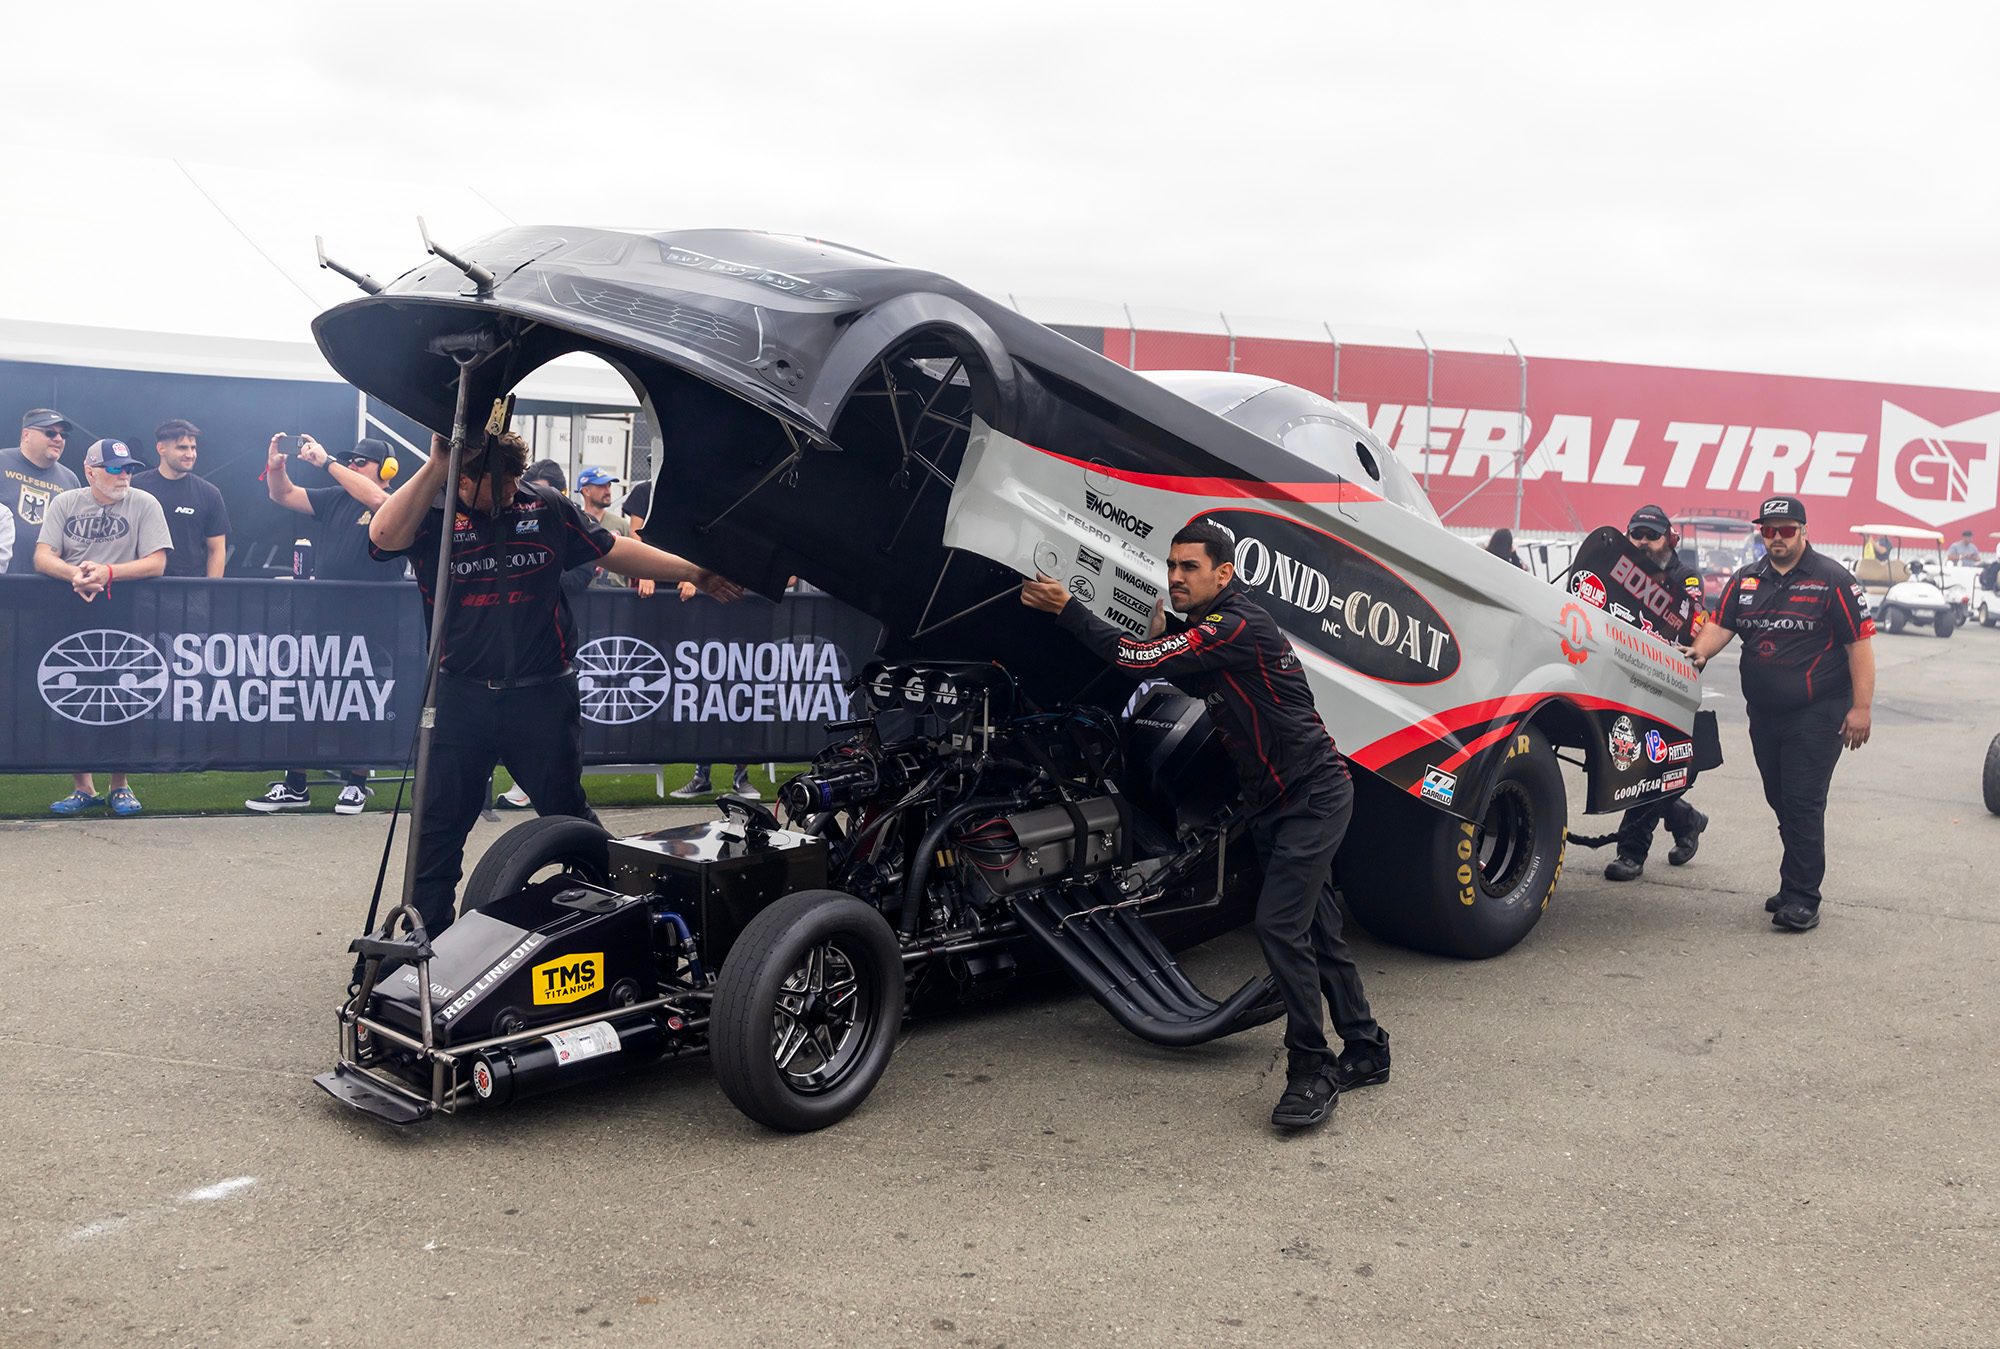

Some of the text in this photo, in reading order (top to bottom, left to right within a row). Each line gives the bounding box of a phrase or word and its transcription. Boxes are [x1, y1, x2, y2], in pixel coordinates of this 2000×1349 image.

[1337, 401, 1868, 497] NERAL TIRE
[74, 518, 119, 538] NHRA
[1067, 513, 1111, 543] FEL-PRO
[1090, 496, 1148, 538] MONROE
[1078, 551, 1103, 570] CHAMPION
[1069, 579, 1093, 600] Gates
[1122, 571, 1158, 598] WAGNER
[1609, 554, 1671, 617] BOXO
[1662, 608, 1684, 631] USA
[1113, 588, 1152, 617] WALKER
[1104, 606, 1147, 636] MOOG
[1321, 618, 1342, 639] INC.
[172, 633, 375, 677] SONOMA
[674, 641, 841, 682] SONOMA
[1136, 645, 1162, 662] SEED
[1605, 623, 1639, 654] LOGAN
[1641, 640, 1698, 682] INDUSTRIES
[1614, 646, 1652, 675] Manufacturing
[1652, 666, 1667, 682] parts
[1671, 675, 1689, 693] bodies
[173, 679, 396, 722] RACEWAY
[674, 683, 853, 722] RACEWAY
[1421, 786, 1451, 805] CARRILLO
[1614, 778, 1661, 800] GOODYEAR
[442, 937, 541, 1019] RED LINE OIL
[541, 959, 596, 991] TMS
[544, 981, 595, 999] TITANIUM
